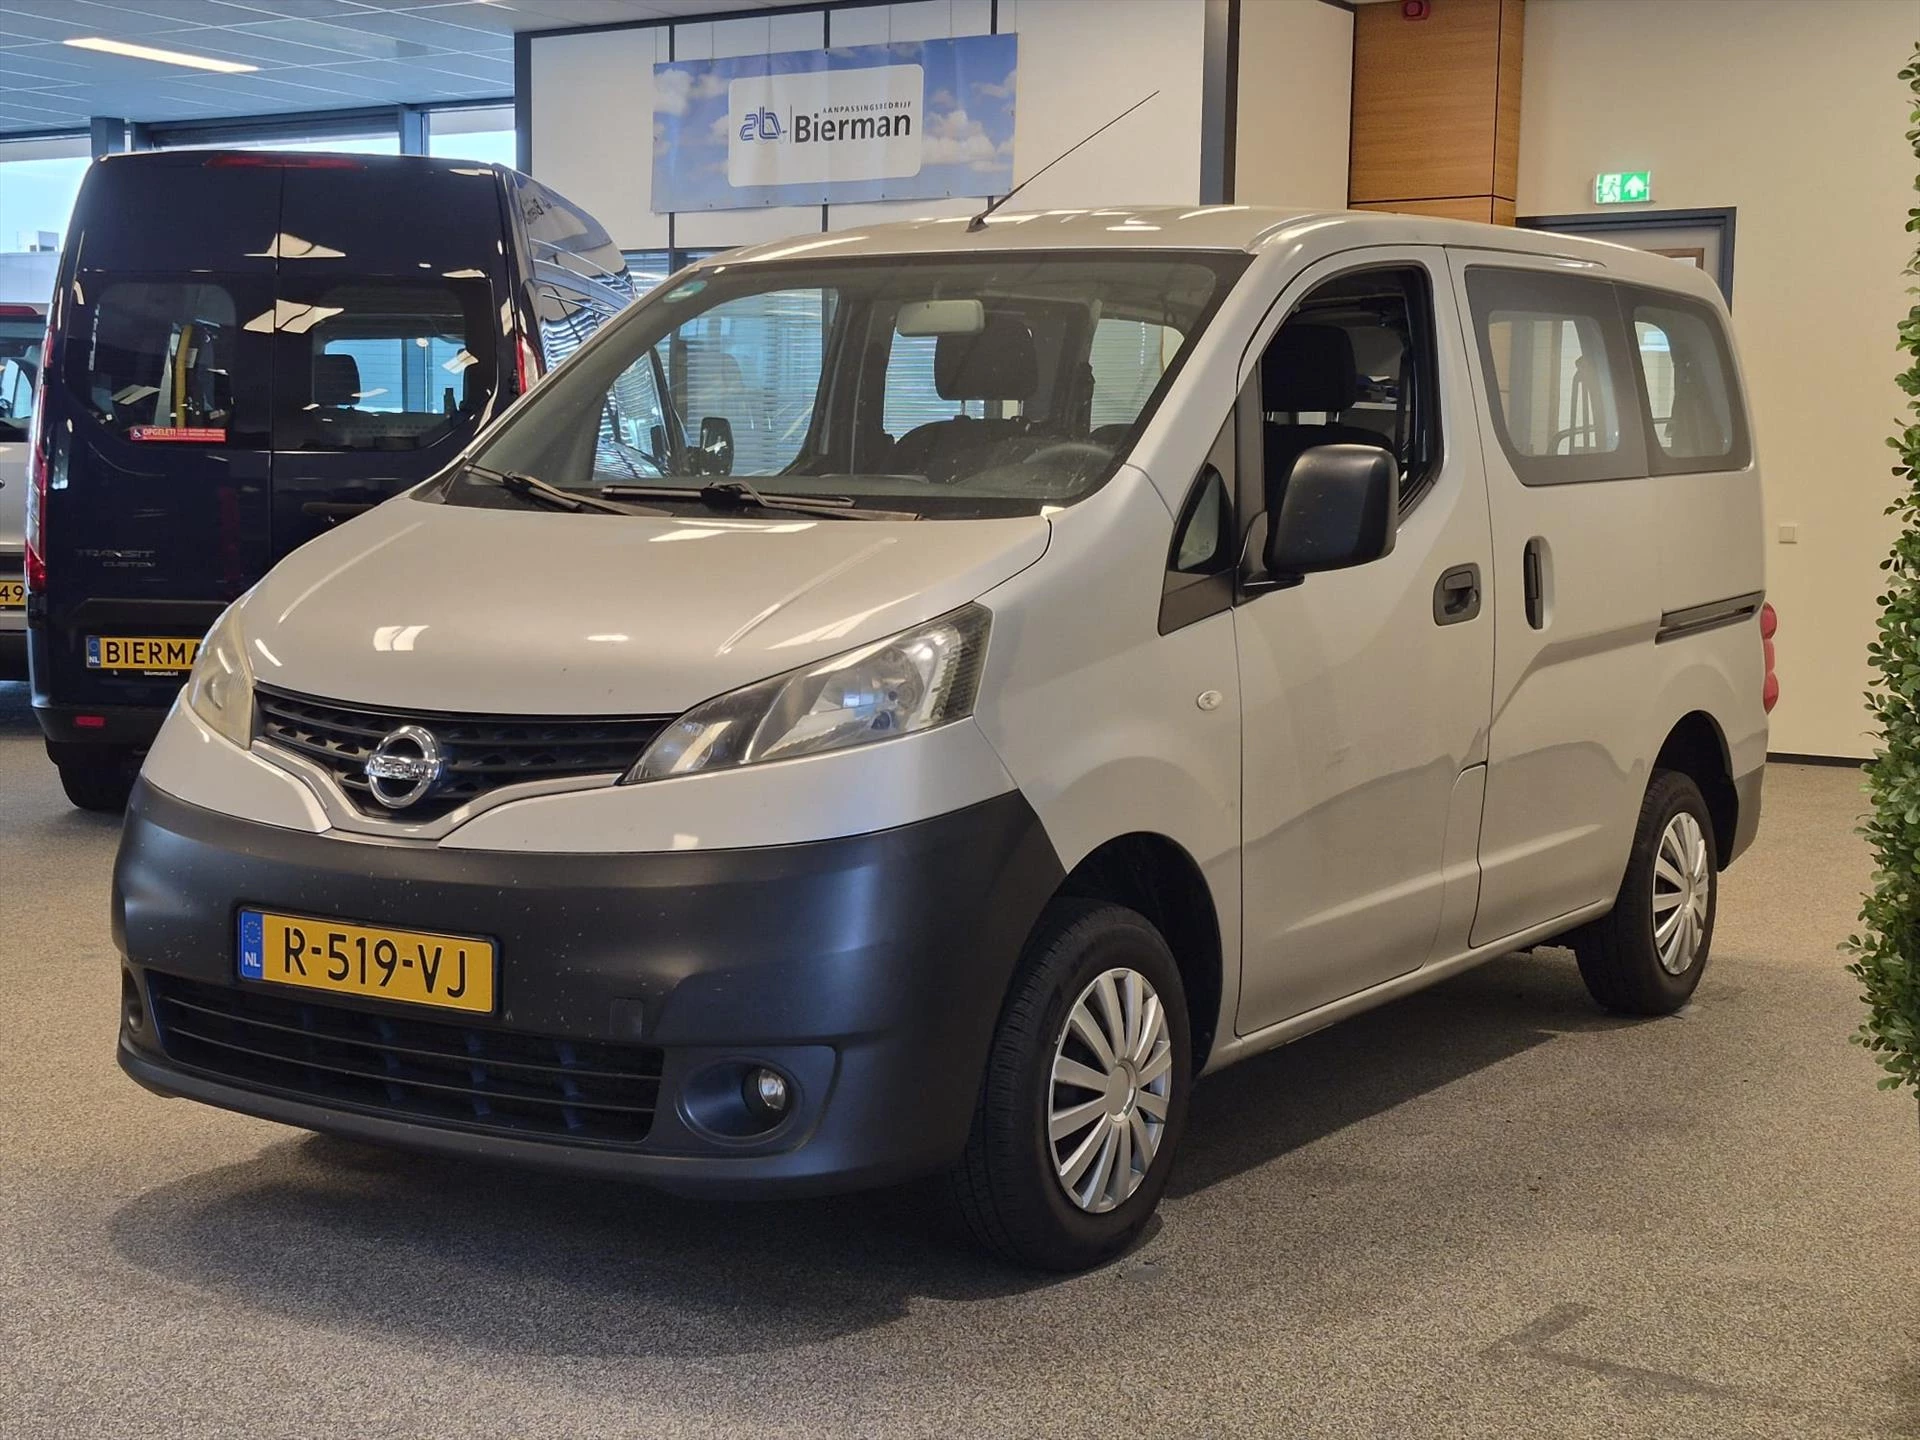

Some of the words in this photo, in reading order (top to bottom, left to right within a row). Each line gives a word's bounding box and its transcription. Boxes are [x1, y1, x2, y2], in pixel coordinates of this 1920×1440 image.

[823, 101, 912, 114] AANPASSINGSBEDRIJF
[795, 113, 911, 143] Bierman
[244, 952, 261, 967] NL
[284, 927, 466, 998] R-519-VJ
